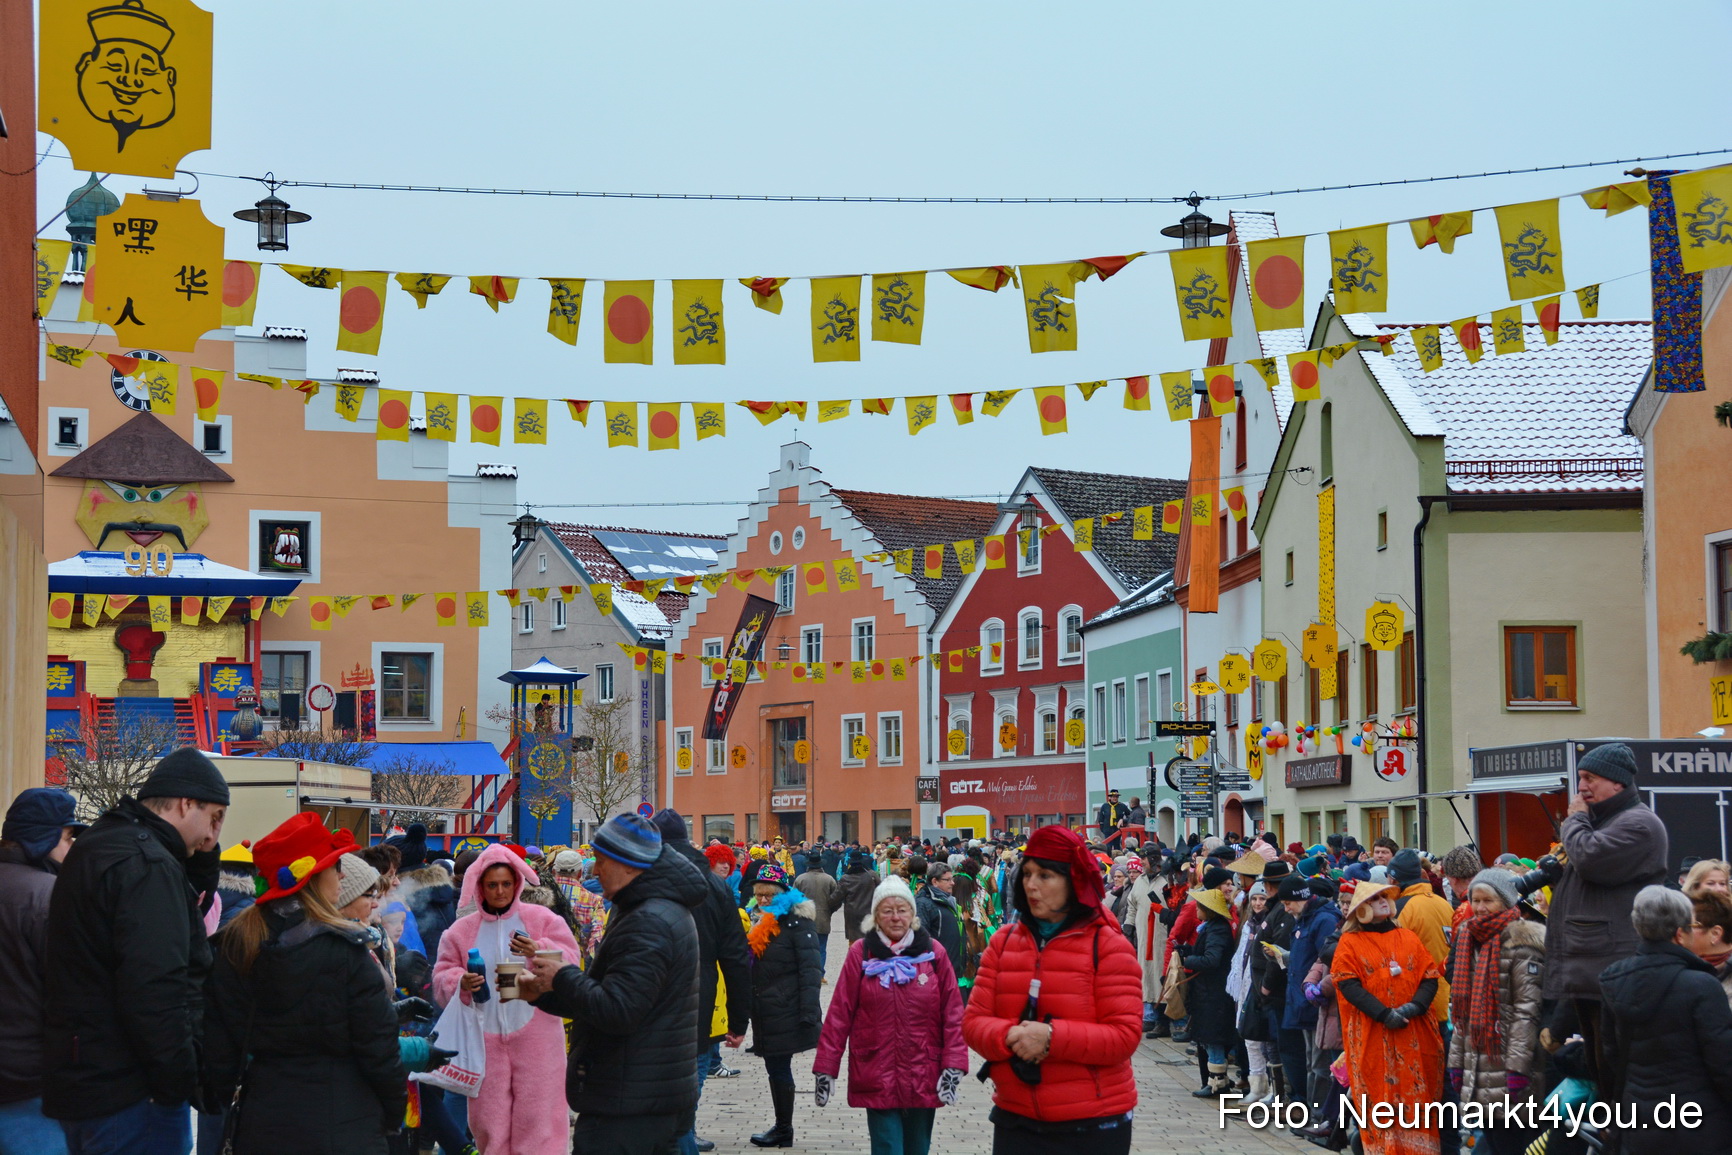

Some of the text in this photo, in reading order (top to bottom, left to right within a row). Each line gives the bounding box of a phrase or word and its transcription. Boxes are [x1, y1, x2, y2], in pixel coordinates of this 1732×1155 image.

[173, 265, 209, 301] 华
[113, 296, 146, 326] 人
[124, 543, 173, 577] 90
[1308, 654, 1315, 663] 人
[1325, 644, 1334, 655] 华
[641, 680, 649, 803] UHREN SCHMUCK
[1483, 753, 1517, 773] IMBISS
[918, 778, 937, 789] CAFÉ
[771, 794, 807, 807] GÖTZ
